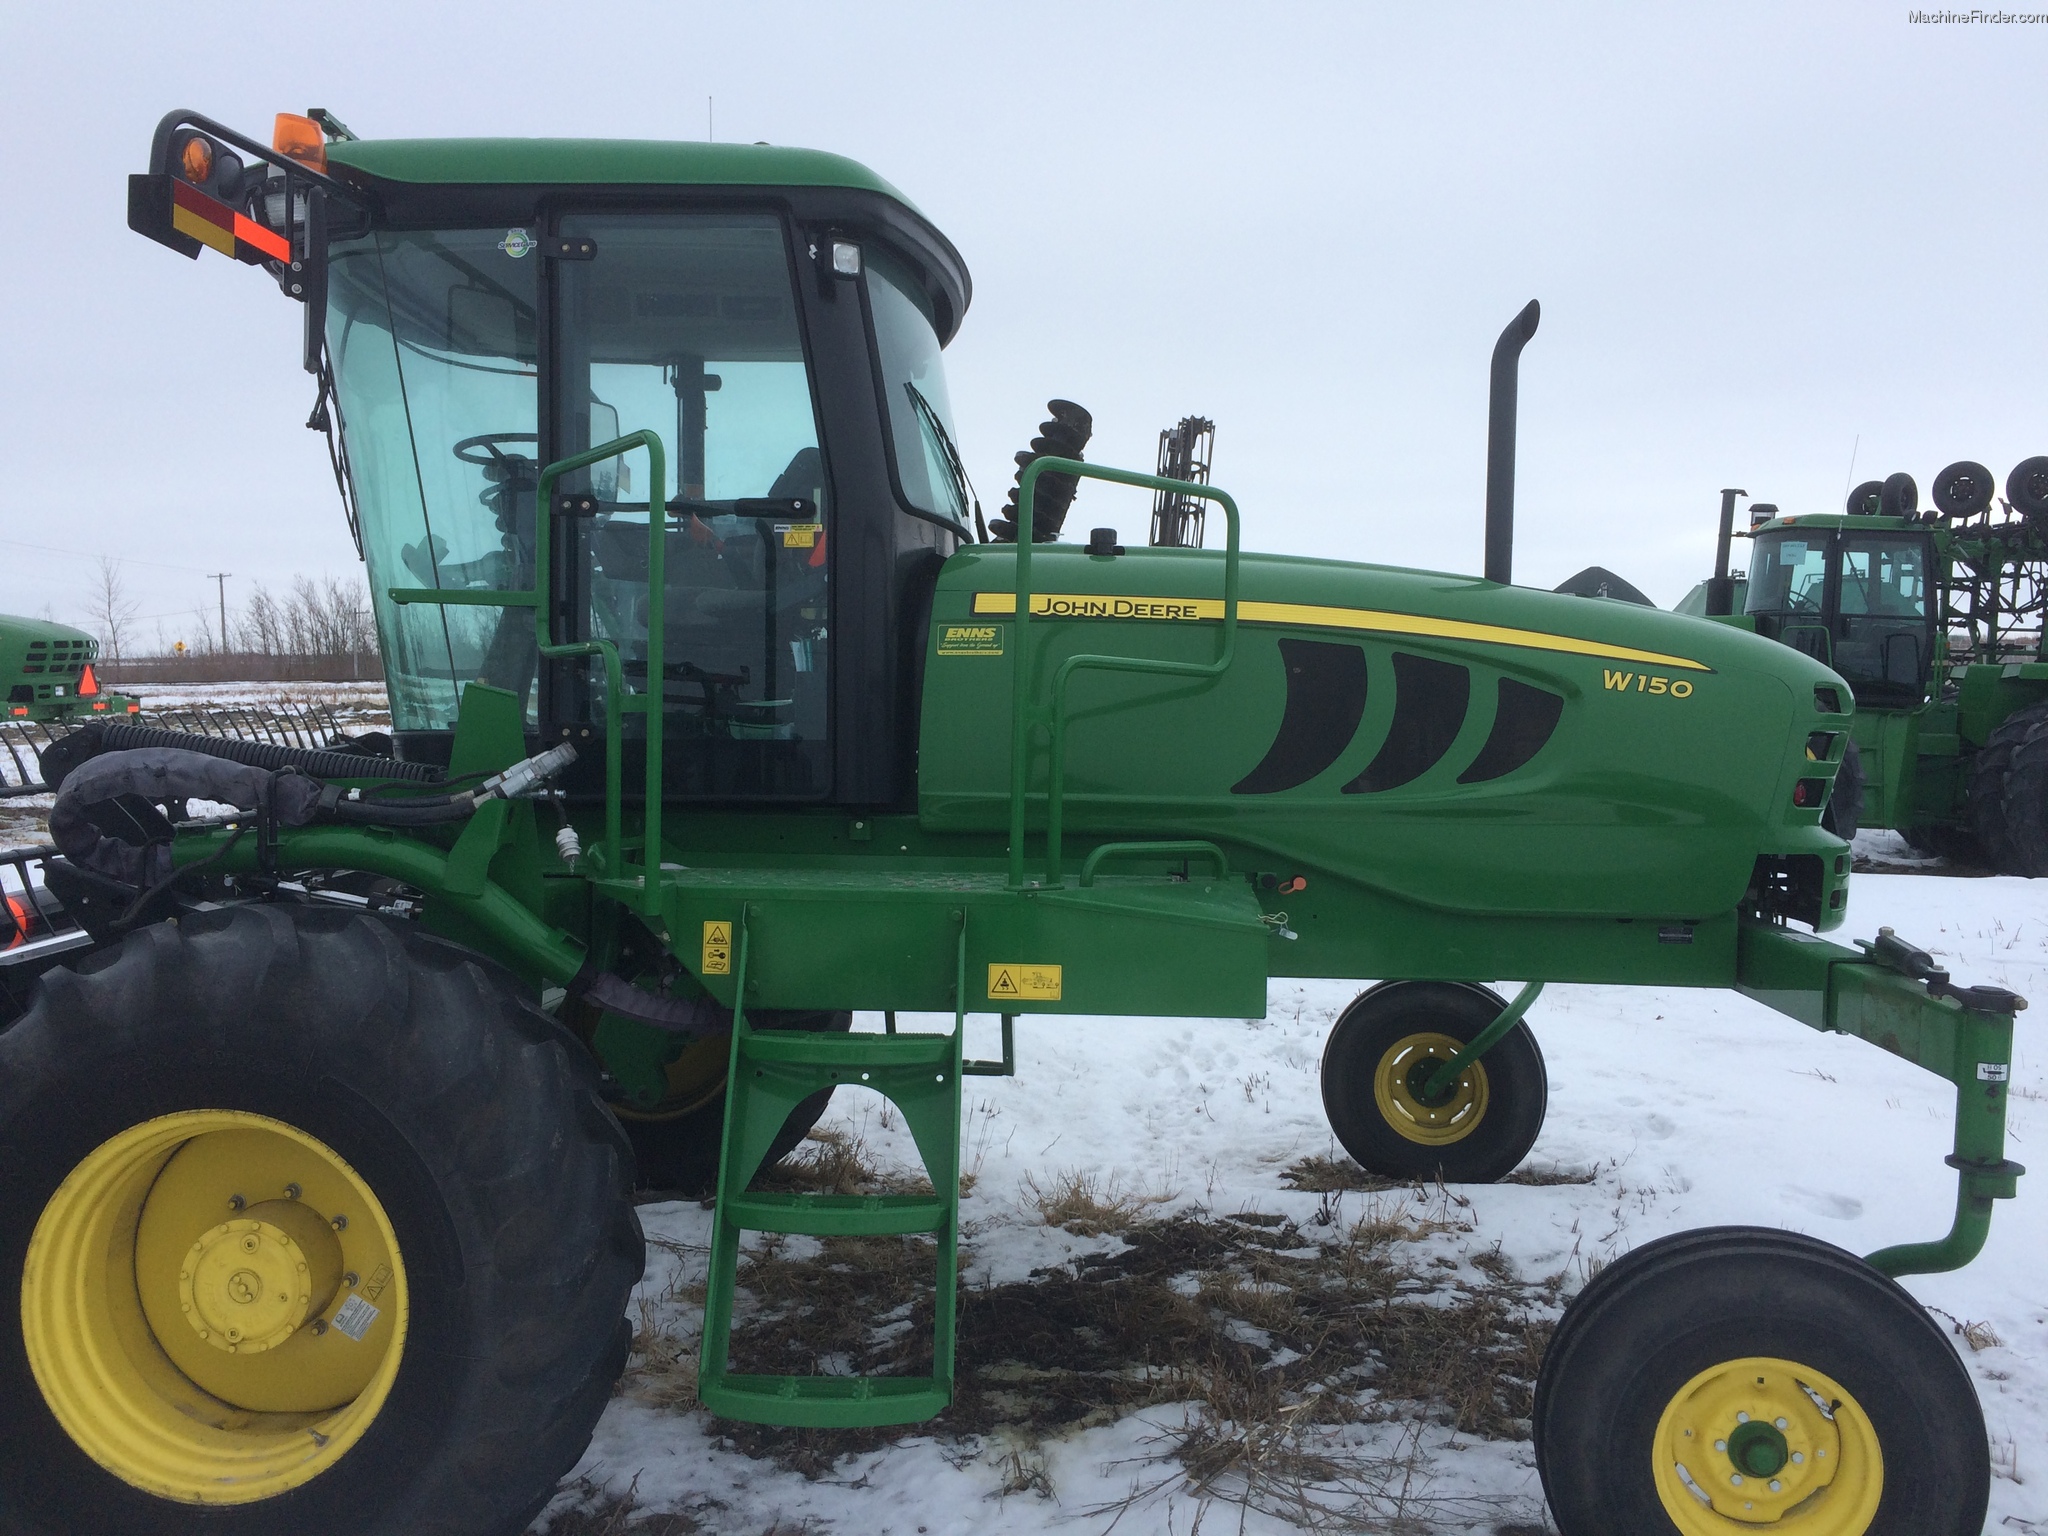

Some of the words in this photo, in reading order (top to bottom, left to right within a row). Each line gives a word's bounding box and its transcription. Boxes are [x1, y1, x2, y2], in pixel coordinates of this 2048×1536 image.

[1037, 598, 1107, 615] JOHN
[1114, 600, 1198, 618] DEERE
[946, 627, 996, 638] ENNS
[1603, 669, 1694, 699] W150
